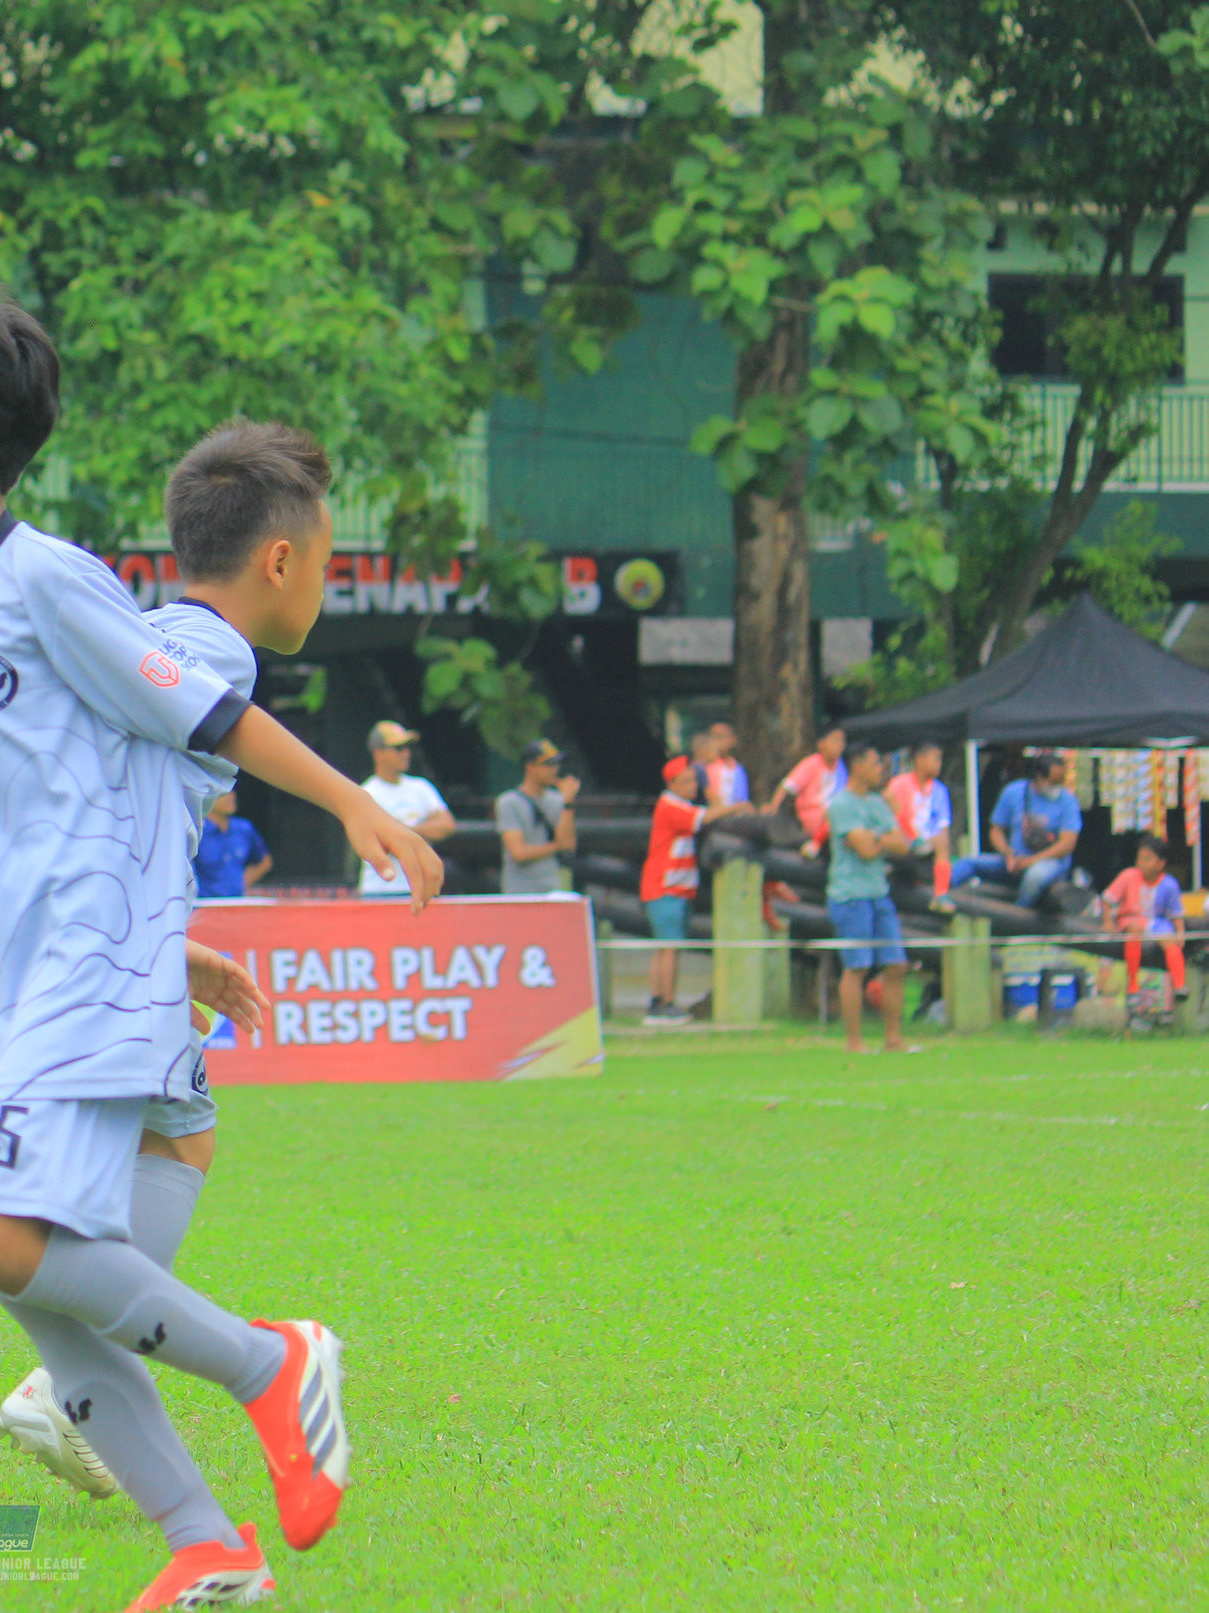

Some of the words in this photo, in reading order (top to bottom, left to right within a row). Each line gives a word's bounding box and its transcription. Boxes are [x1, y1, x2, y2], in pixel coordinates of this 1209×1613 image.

[562, 556, 601, 615] B
[270, 948, 379, 993] FAIR
[391, 943, 506, 990] PLAY
[519, 945, 556, 987] &
[273, 996, 473, 1045] RESPECT
